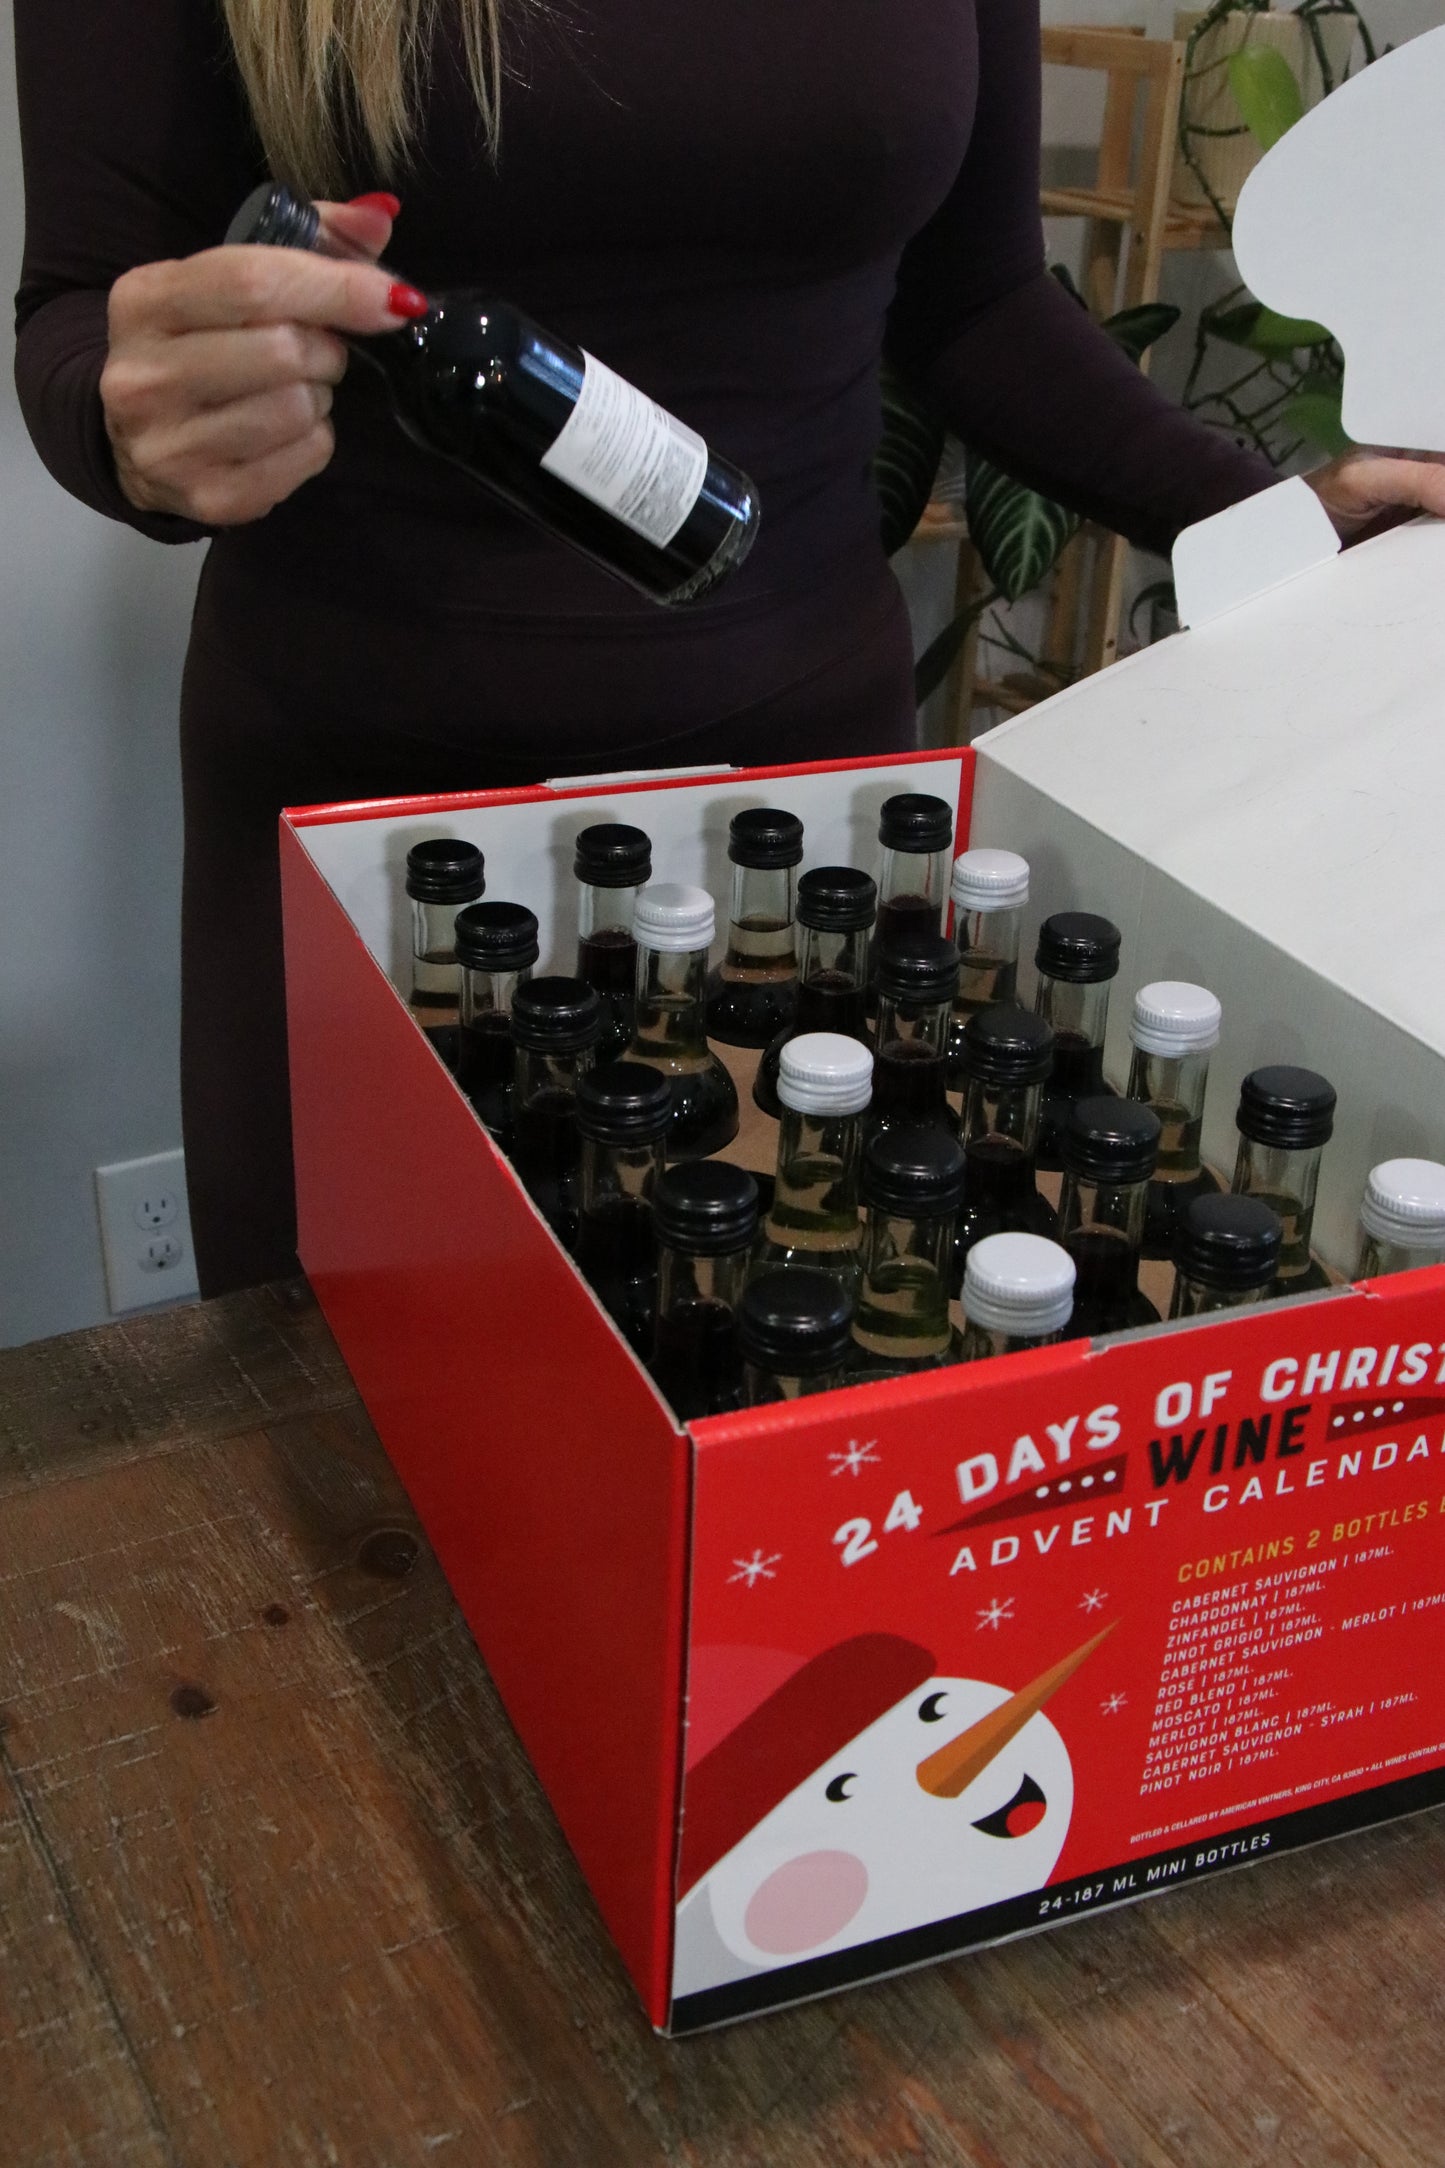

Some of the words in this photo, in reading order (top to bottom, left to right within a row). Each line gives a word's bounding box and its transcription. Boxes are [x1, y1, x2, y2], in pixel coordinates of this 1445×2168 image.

[832, 1489, 923, 1568] 24
[955, 1403, 1121, 1504] DAYS
[1153, 1370, 1232, 1428] OF
[1147, 1403, 1312, 1489] WINE
[949, 1499, 1168, 1576] ADVENT
[1203, 1432, 1445, 1513] CALENDA
[1177, 1537, 1295, 1582] CONTAINS
[1305, 1530, 1321, 1548] 2
[1331, 1501, 1429, 1541] BOTTLES
[1169, 1595, 1267, 1630] CHARDONNAY
[1172, 1583, 1248, 1613] CABERNET
[1255, 1559, 1337, 1590] SAUVIGNON
[1161, 1652, 1236, 1681] CABERNET
[1242, 1627, 1323, 1658] SAUVIGNON
[1341, 1607, 1396, 1629] MERLOT
[1163, 1644, 1207, 1664] PINOT
[1213, 1628, 1263, 1651] GRIGIO
[1166, 1618, 1246, 1648] ZINFANDEL
[1152, 1703, 1221, 1731] MOSCATO
[1154, 1699, 1183, 1715] RED
[1189, 1684, 1236, 1705] BLEND
[1143, 1750, 1216, 1779] CABERNET
[1222, 1724, 1303, 1755] SAUVIGNON
[1320, 1707, 1364, 1726] SYRAH
[1145, 1731, 1228, 1763] SAUVIGNON
[1234, 1717, 1280, 1737] BLANC
[1149, 1723, 1206, 1747] MERLOT
[1130, 1828, 1162, 1843] BOTTLED
[1171, 1815, 1207, 1830] CELLARED
[1220, 1800, 1257, 1815] AMERICAN
[1370, 1762, 1383, 1770] ALL
[1385, 1755, 1407, 1766] WINES
[1408, 1746, 1437, 1759] CONTAIN
[1140, 1775, 1182, 1794] PINOT
[1188, 1763, 1222, 1780] NOIR
[1038, 1884, 1104, 1914] 24-187
[1113, 1875, 1137, 1891] ML
[1146, 1859, 1187, 1881] MINI
[1195, 1834, 1271, 1866] BOTTLES
